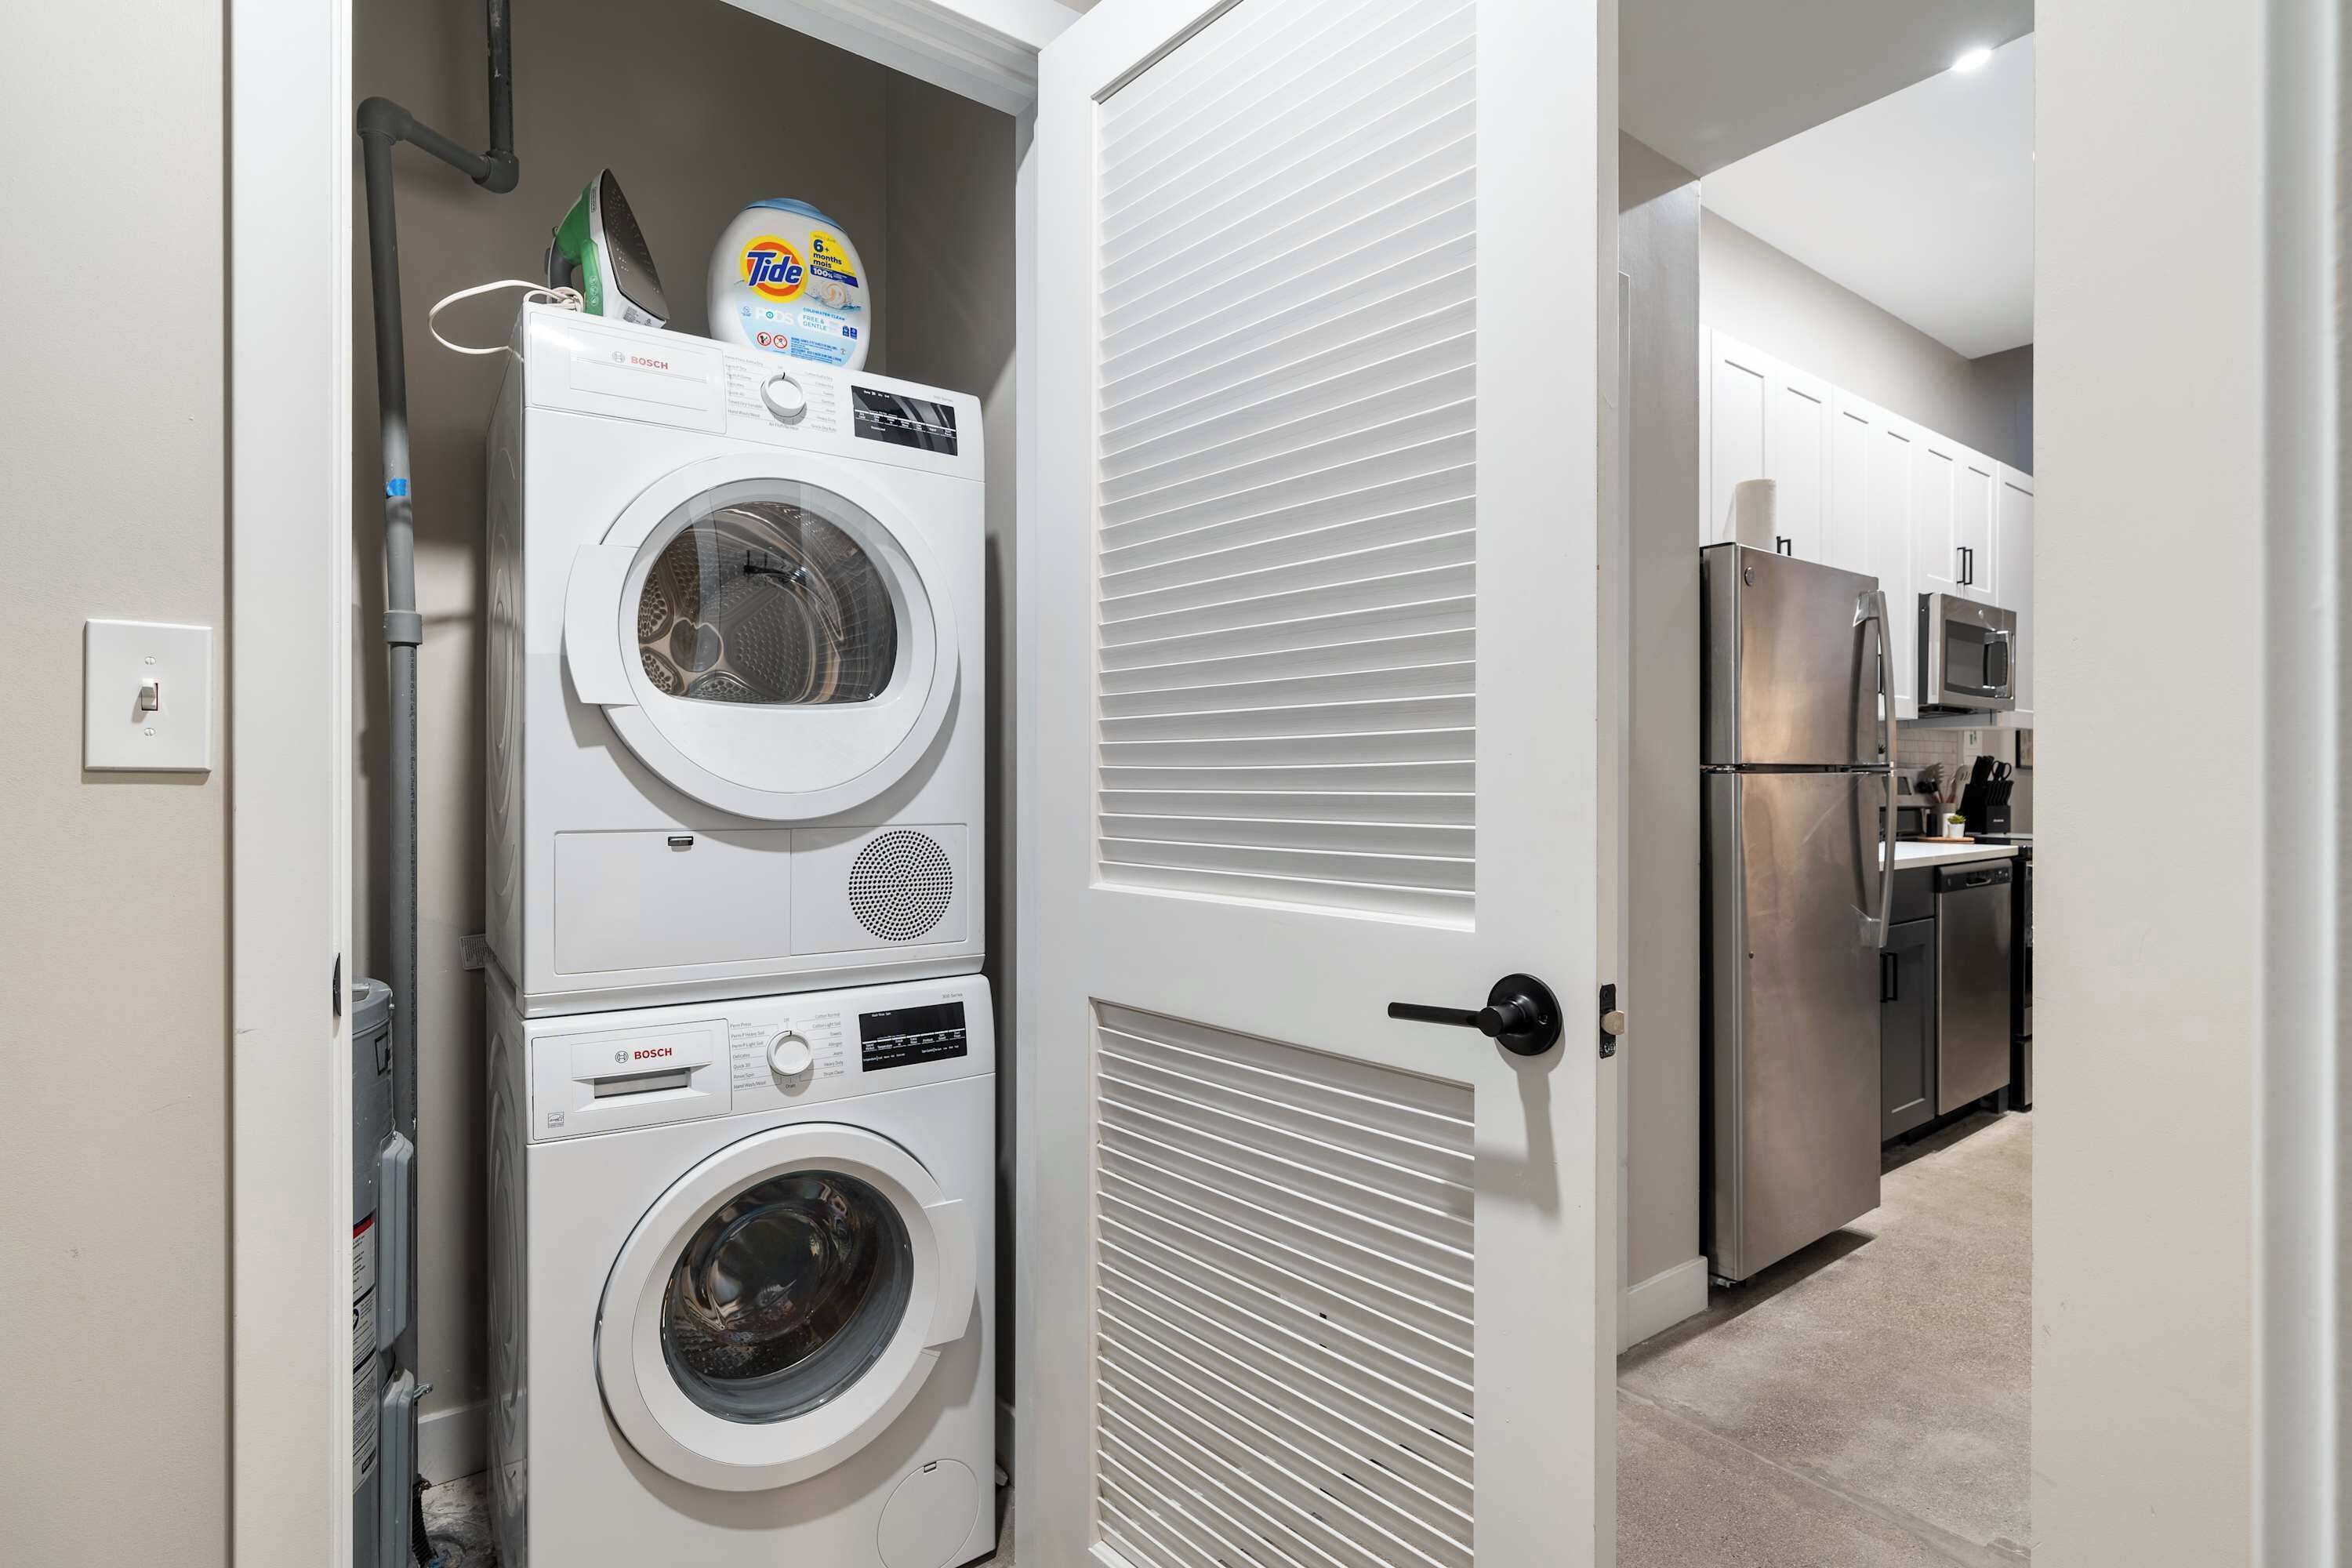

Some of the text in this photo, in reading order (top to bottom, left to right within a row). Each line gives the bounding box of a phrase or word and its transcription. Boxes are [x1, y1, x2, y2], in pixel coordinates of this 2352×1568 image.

[813, 252, 842, 265] months
[813, 260, 832, 268] mois
[747, 252, 804, 287] Tide
[814, 267, 833, 278] 100%
[803, 314, 820, 323] FREE
[803, 321, 827, 331] GENTLE
[631, 356, 668, 369] BOSCH
[634, 1047, 672, 1060] BOSCH
